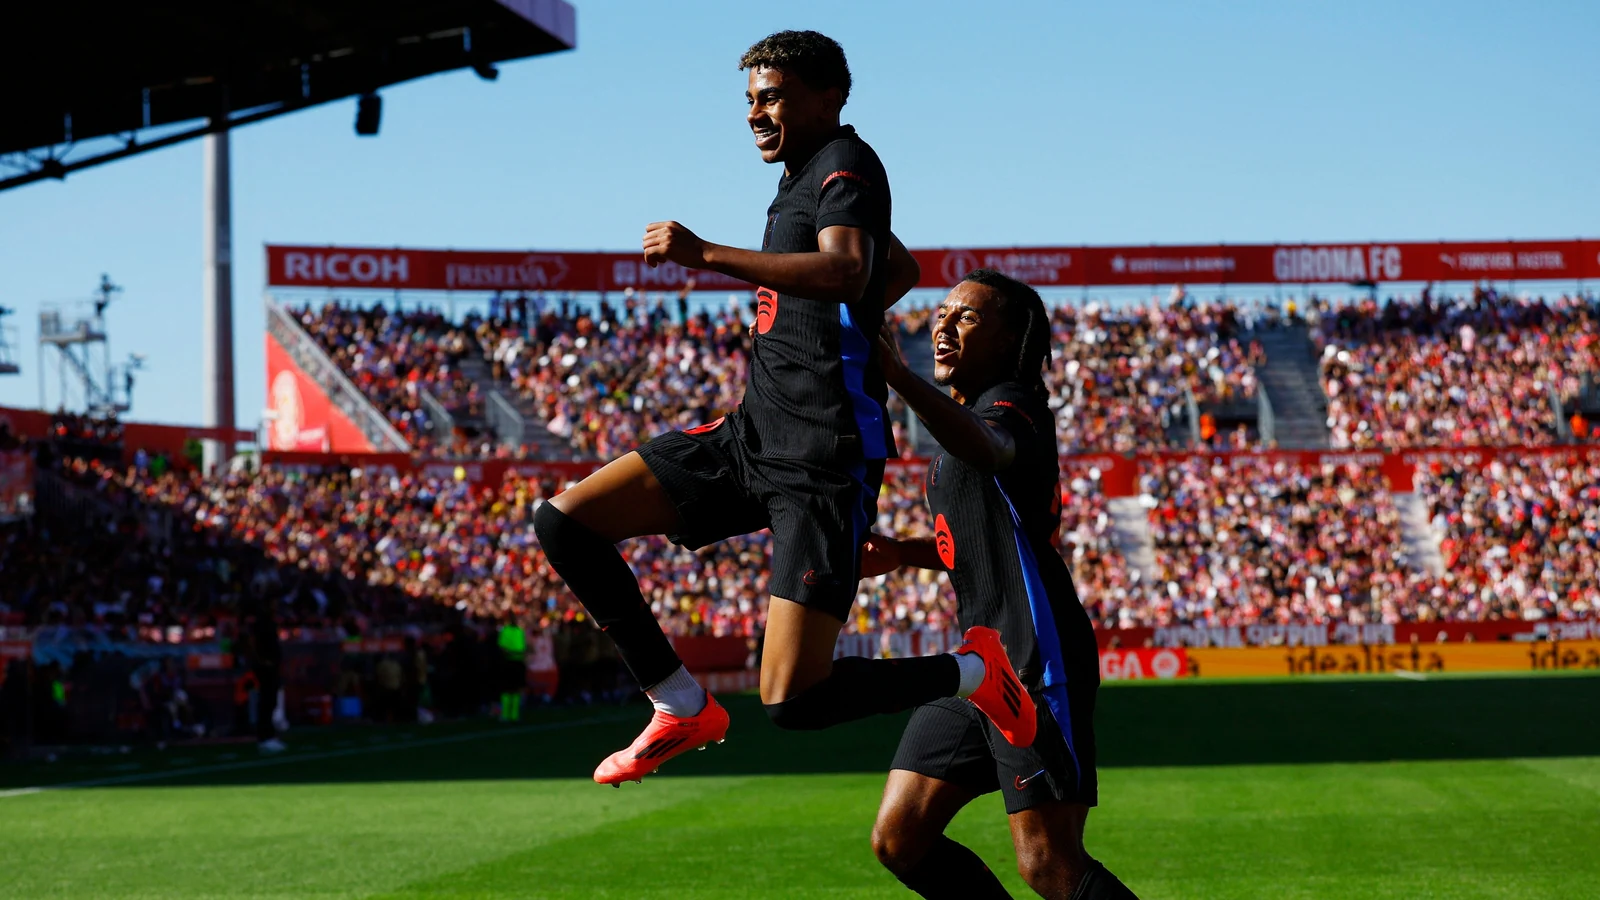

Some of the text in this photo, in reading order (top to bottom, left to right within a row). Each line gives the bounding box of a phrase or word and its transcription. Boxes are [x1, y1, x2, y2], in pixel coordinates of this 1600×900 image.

[285, 252, 409, 282] RICOH
[1273, 246, 1402, 280] GIRONA FC
[1285, 644, 1444, 673] idealista
